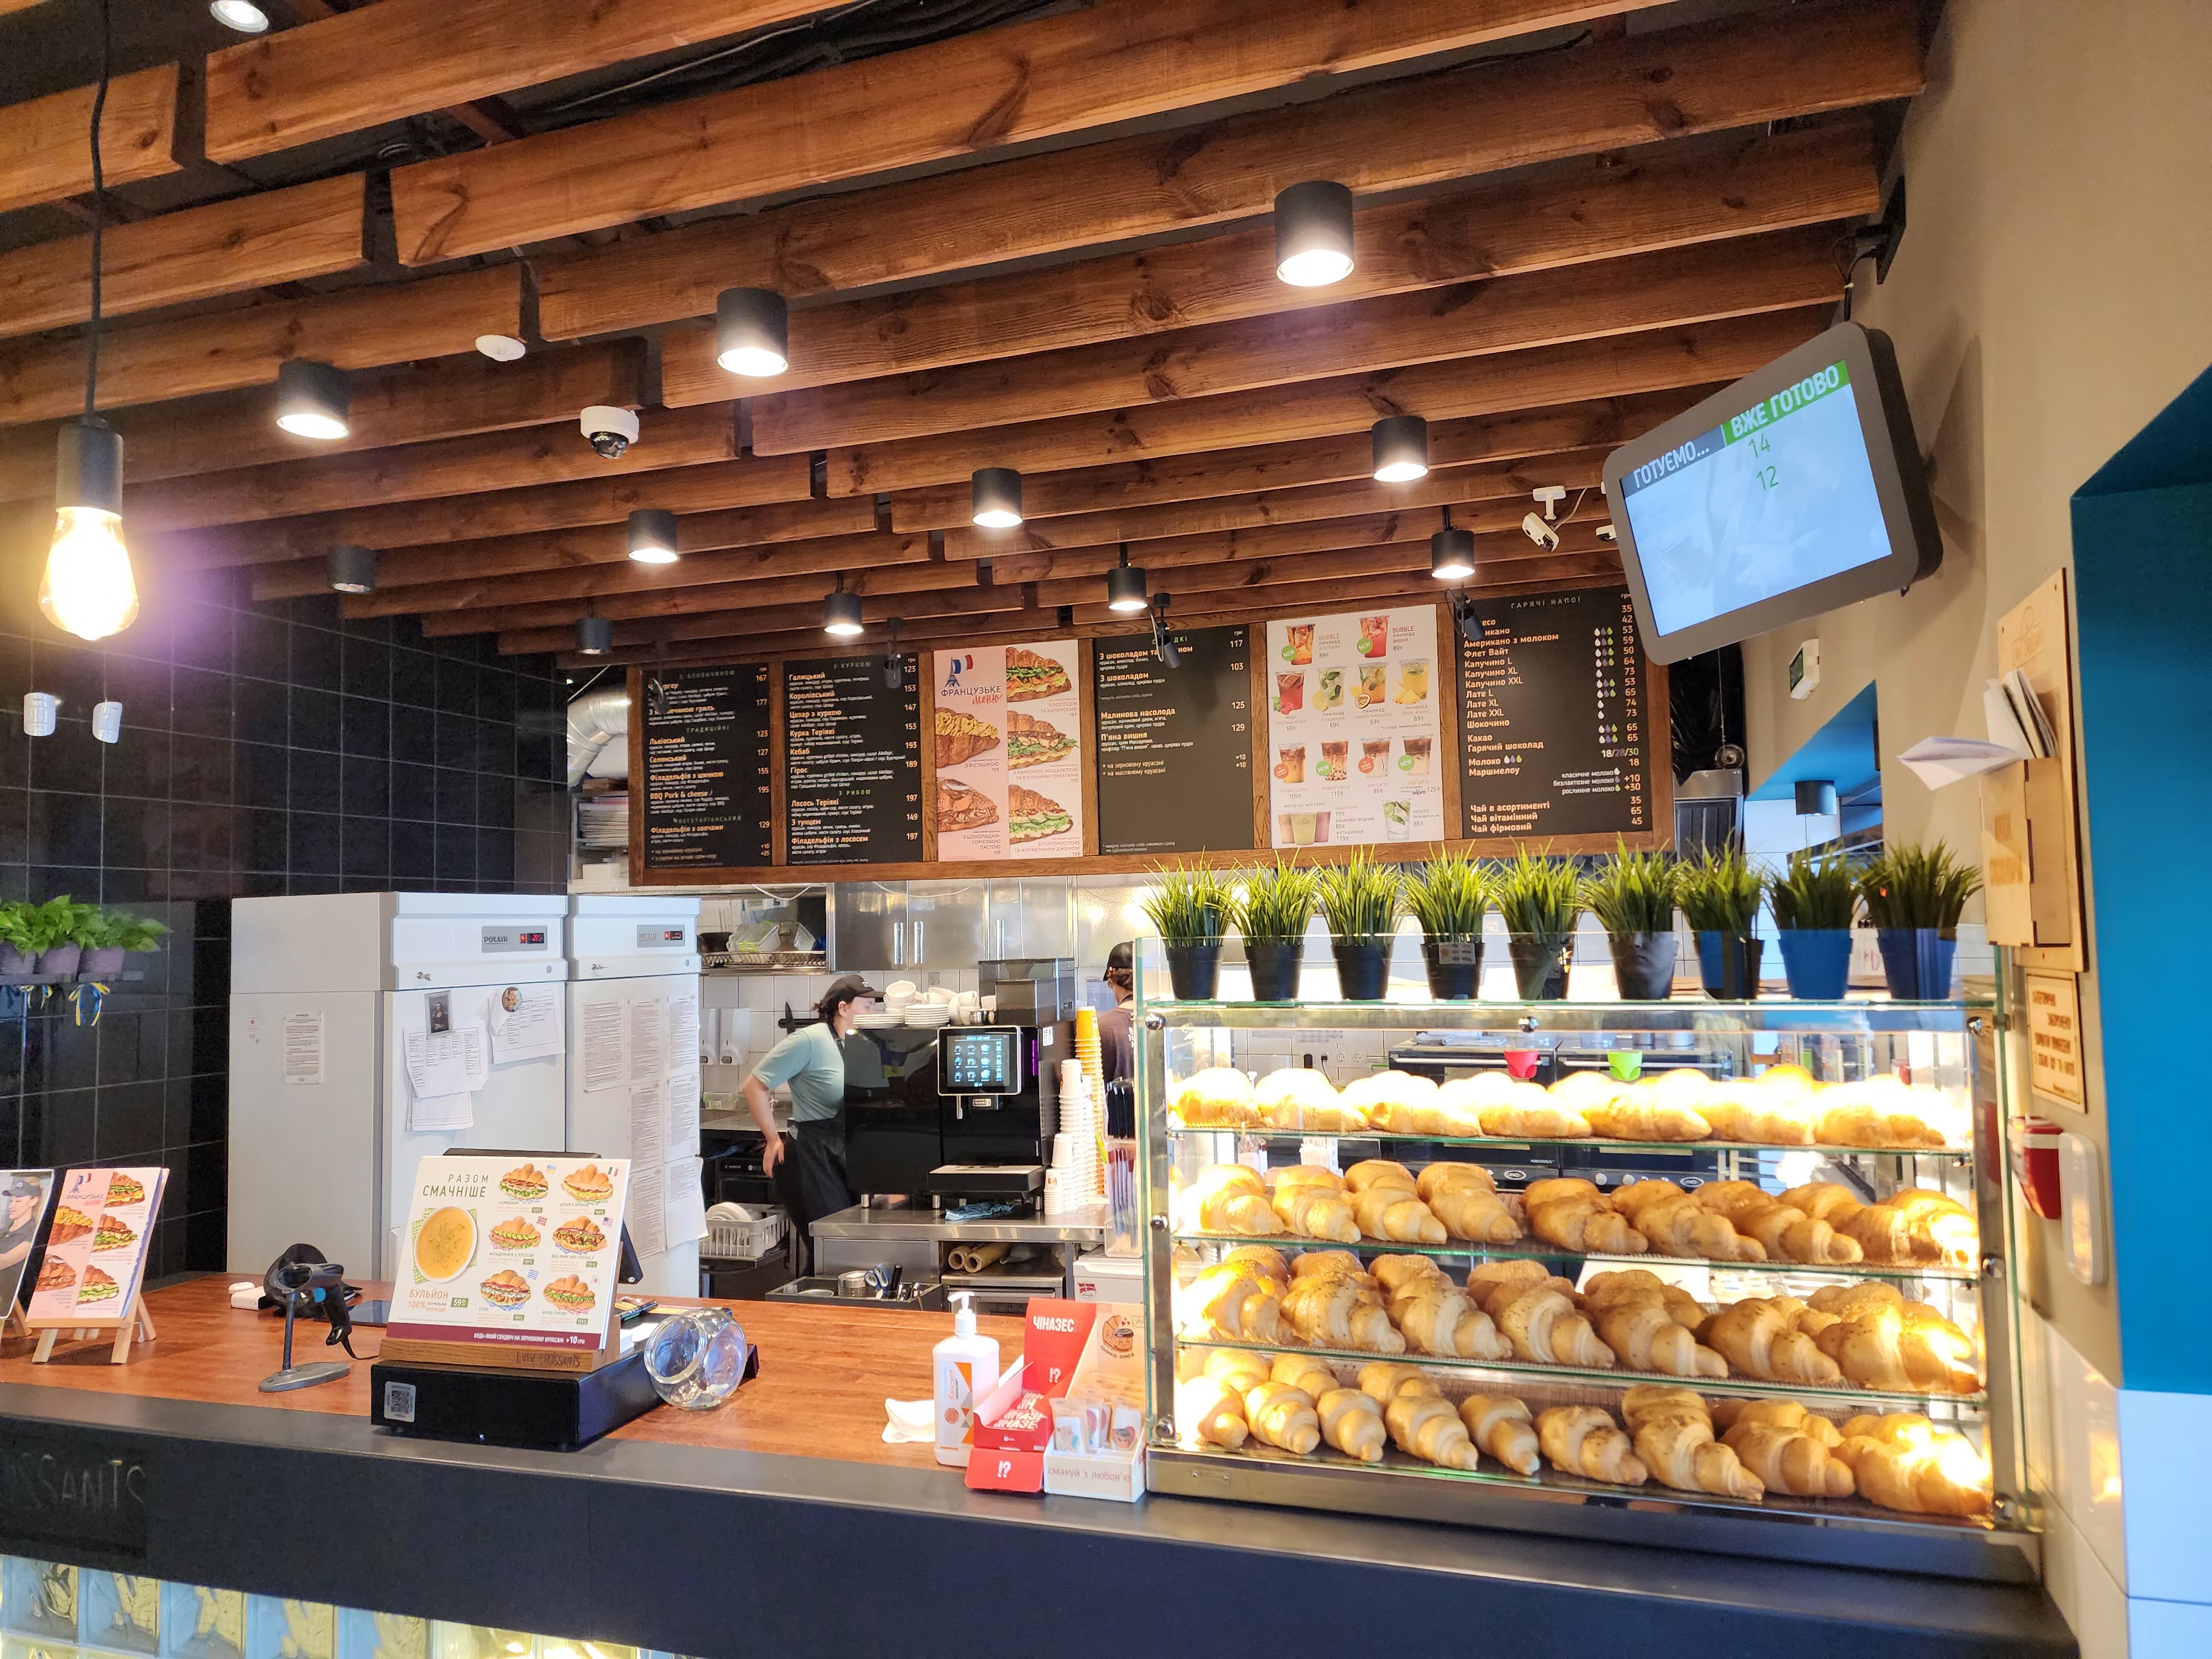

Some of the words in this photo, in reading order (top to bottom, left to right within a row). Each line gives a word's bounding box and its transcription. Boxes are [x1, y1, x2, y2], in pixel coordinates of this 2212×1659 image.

[1731, 403, 1767, 438] ВЖЕ
[1770, 365, 1839, 418] ГОТОВО
[1749, 434, 1770, 458] 14
[1756, 466, 1778, 491] 12
[1511, 601, 1545, 609] ГАРЯЧІ
[1551, 596, 1582, 604] НАПОЇ
[1230, 640, 1243, 648] 117
[1359, 641, 1371, 650] NEW
[1464, 638, 1510, 648] Американо
[1521, 634, 1559, 643] молоком
[1106, 650, 1148, 659] шоколадом
[1283, 649, 1295, 657] NEW
[1230, 662, 1243, 671] 103
[1465, 659, 1505, 669] Капучино
[789, 672, 825, 681] Галицький
[1107, 672, 1149, 681] шоколадом
[1465, 669, 1505, 678] Капучино
[1465, 679, 1506, 688] Капучино
[789, 690, 834, 700] Королівський
[941, 685, 1001, 697] ФРАНЦУЗЬКЕ
[1232, 701, 1245, 709] 125
[1101, 711, 1138, 719] Малинова
[1140, 708, 1176, 717] насолода
[1232, 723, 1245, 732] 129
[1467, 720, 1510, 729] Шокочино
[790, 747, 810, 755] Кебаб
[1468, 743, 1503, 753] Гарячий
[1505, 742, 1543, 750] шоколад
[1468, 757, 1501, 766] Молоко
[1469, 767, 1520, 778] Маршмелоу
[816, 799, 839, 807] Теріякі
[1471, 804, 1486, 812] Чай
[1497, 801, 1550, 812] асортименті
[1471, 814, 1486, 822] Чай
[1489, 812, 1537, 822] вітамінний
[1472, 825, 1488, 833] Чай
[1490, 823, 1532, 833] фірмовий
[448, 1173, 489, 1183] РАЗОМ
[422, 1185, 486, 1197] СМАЧНІШЕ
[409, 1289, 448, 1300] БУЛЬЙОН
[408, 1301, 425, 1309] 100%
[1033, 1316, 1074, 1332] ЧІНАЗЕС
[1049, 1368, 1061, 1383] !?
[997, 1460, 1011, 1478] !?
[1048, 1468, 1079, 1479] смакуй
[1092, 1472, 1130, 1482] любов'ю
